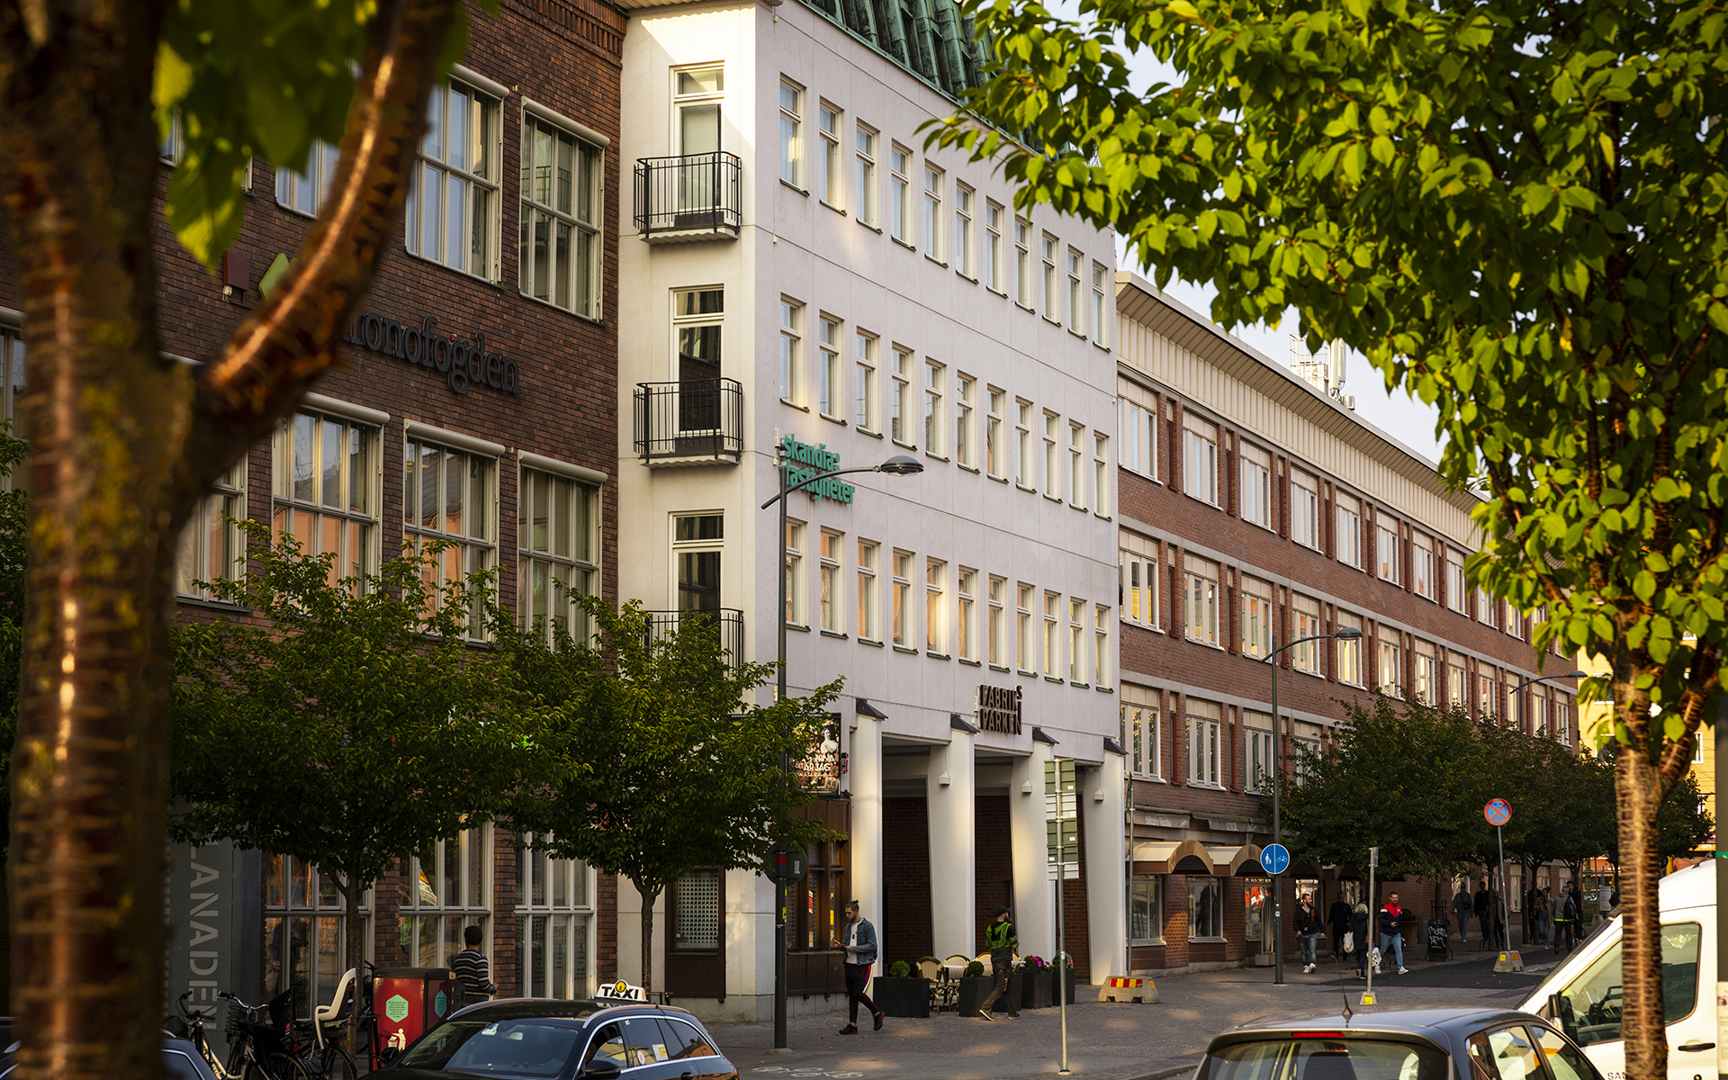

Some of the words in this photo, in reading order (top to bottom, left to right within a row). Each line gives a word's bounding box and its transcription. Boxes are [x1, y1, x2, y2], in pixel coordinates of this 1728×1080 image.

[343, 312, 521, 394] ronofogden
[785, 459, 856, 504] fastigheter
[979, 701, 1023, 736] PARKEN
[187, 833, 220, 1030] LANADEN
[601, 986, 639, 1000] TAXI
